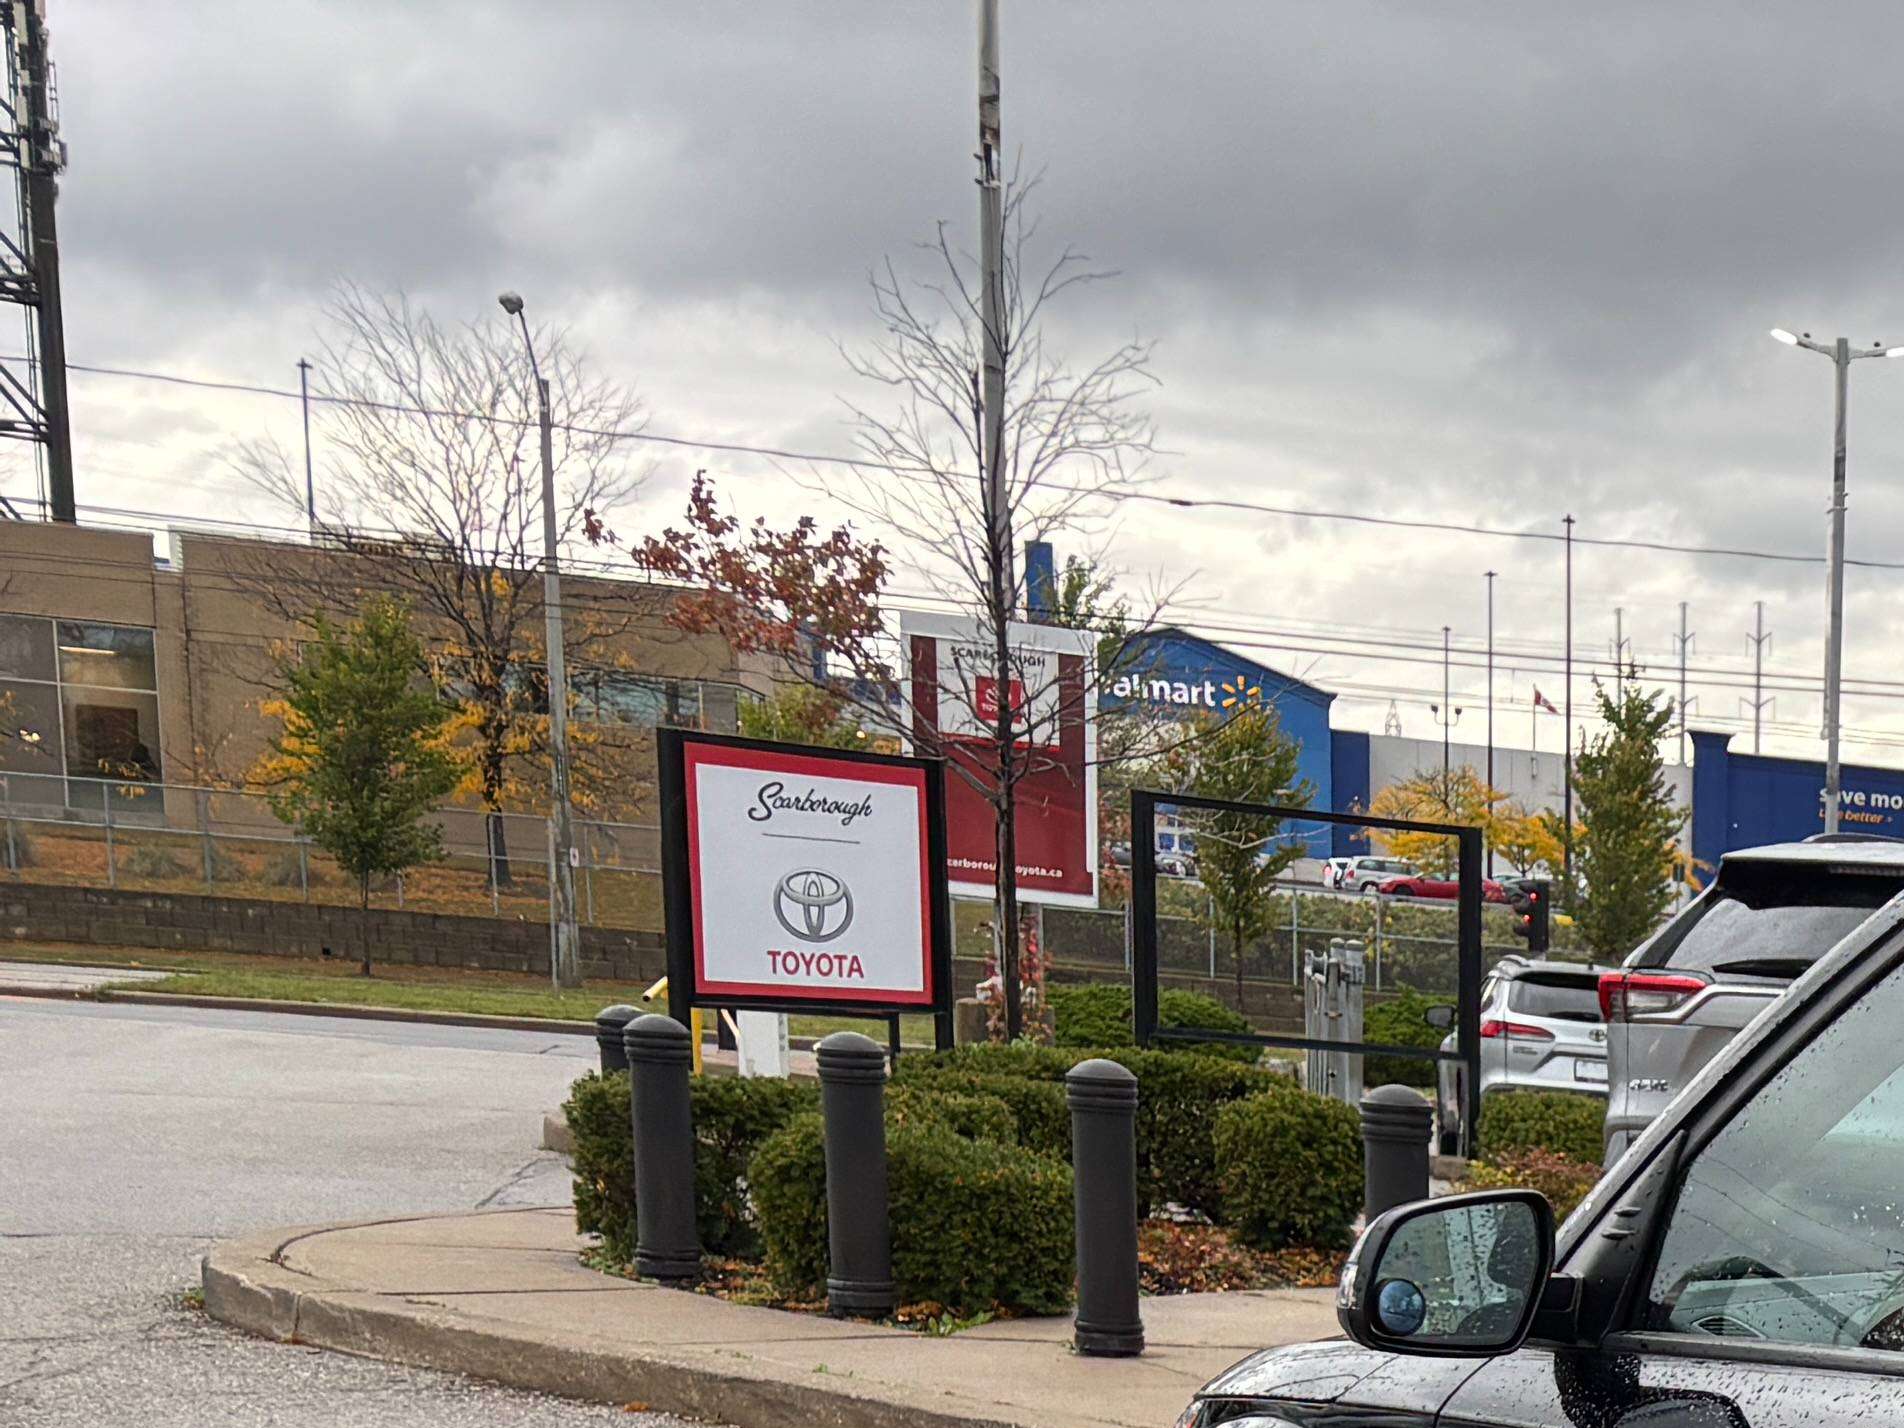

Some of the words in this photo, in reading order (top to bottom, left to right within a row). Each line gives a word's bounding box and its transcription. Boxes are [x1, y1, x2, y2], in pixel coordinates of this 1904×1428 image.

[748, 781, 872, 826] Scarborough
[946, 858, 1063, 878] carborouoyota.ca
[767, 950, 864, 979] TOYOTA
